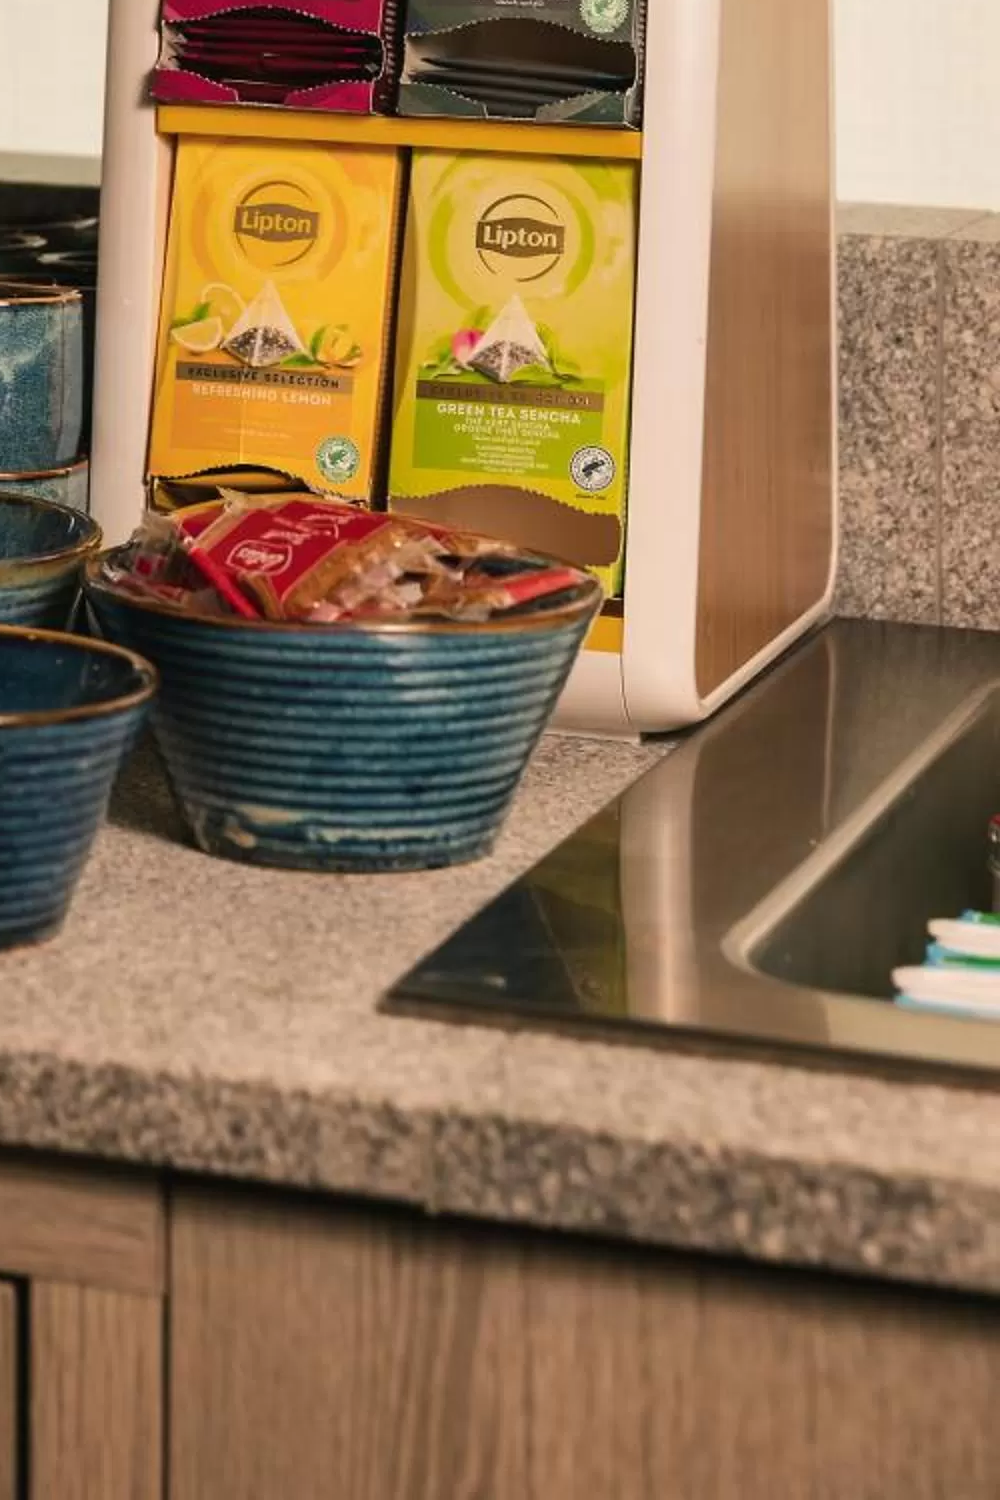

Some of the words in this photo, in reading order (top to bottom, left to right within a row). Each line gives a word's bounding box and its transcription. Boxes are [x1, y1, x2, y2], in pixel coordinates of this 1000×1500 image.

[241, 211, 312, 234] Lipton
[483, 226, 557, 249] Lipton
[187, 367, 257, 381] EXCLUSIVE
[264, 373, 340, 389] SELECTION
[192, 383, 277, 401] REFRESHING
[282, 390, 331, 405] LEMON
[437, 403, 485, 417] GREEN
[489, 405, 515, 419] TEA
[519, 409, 581, 425] SENCHA
